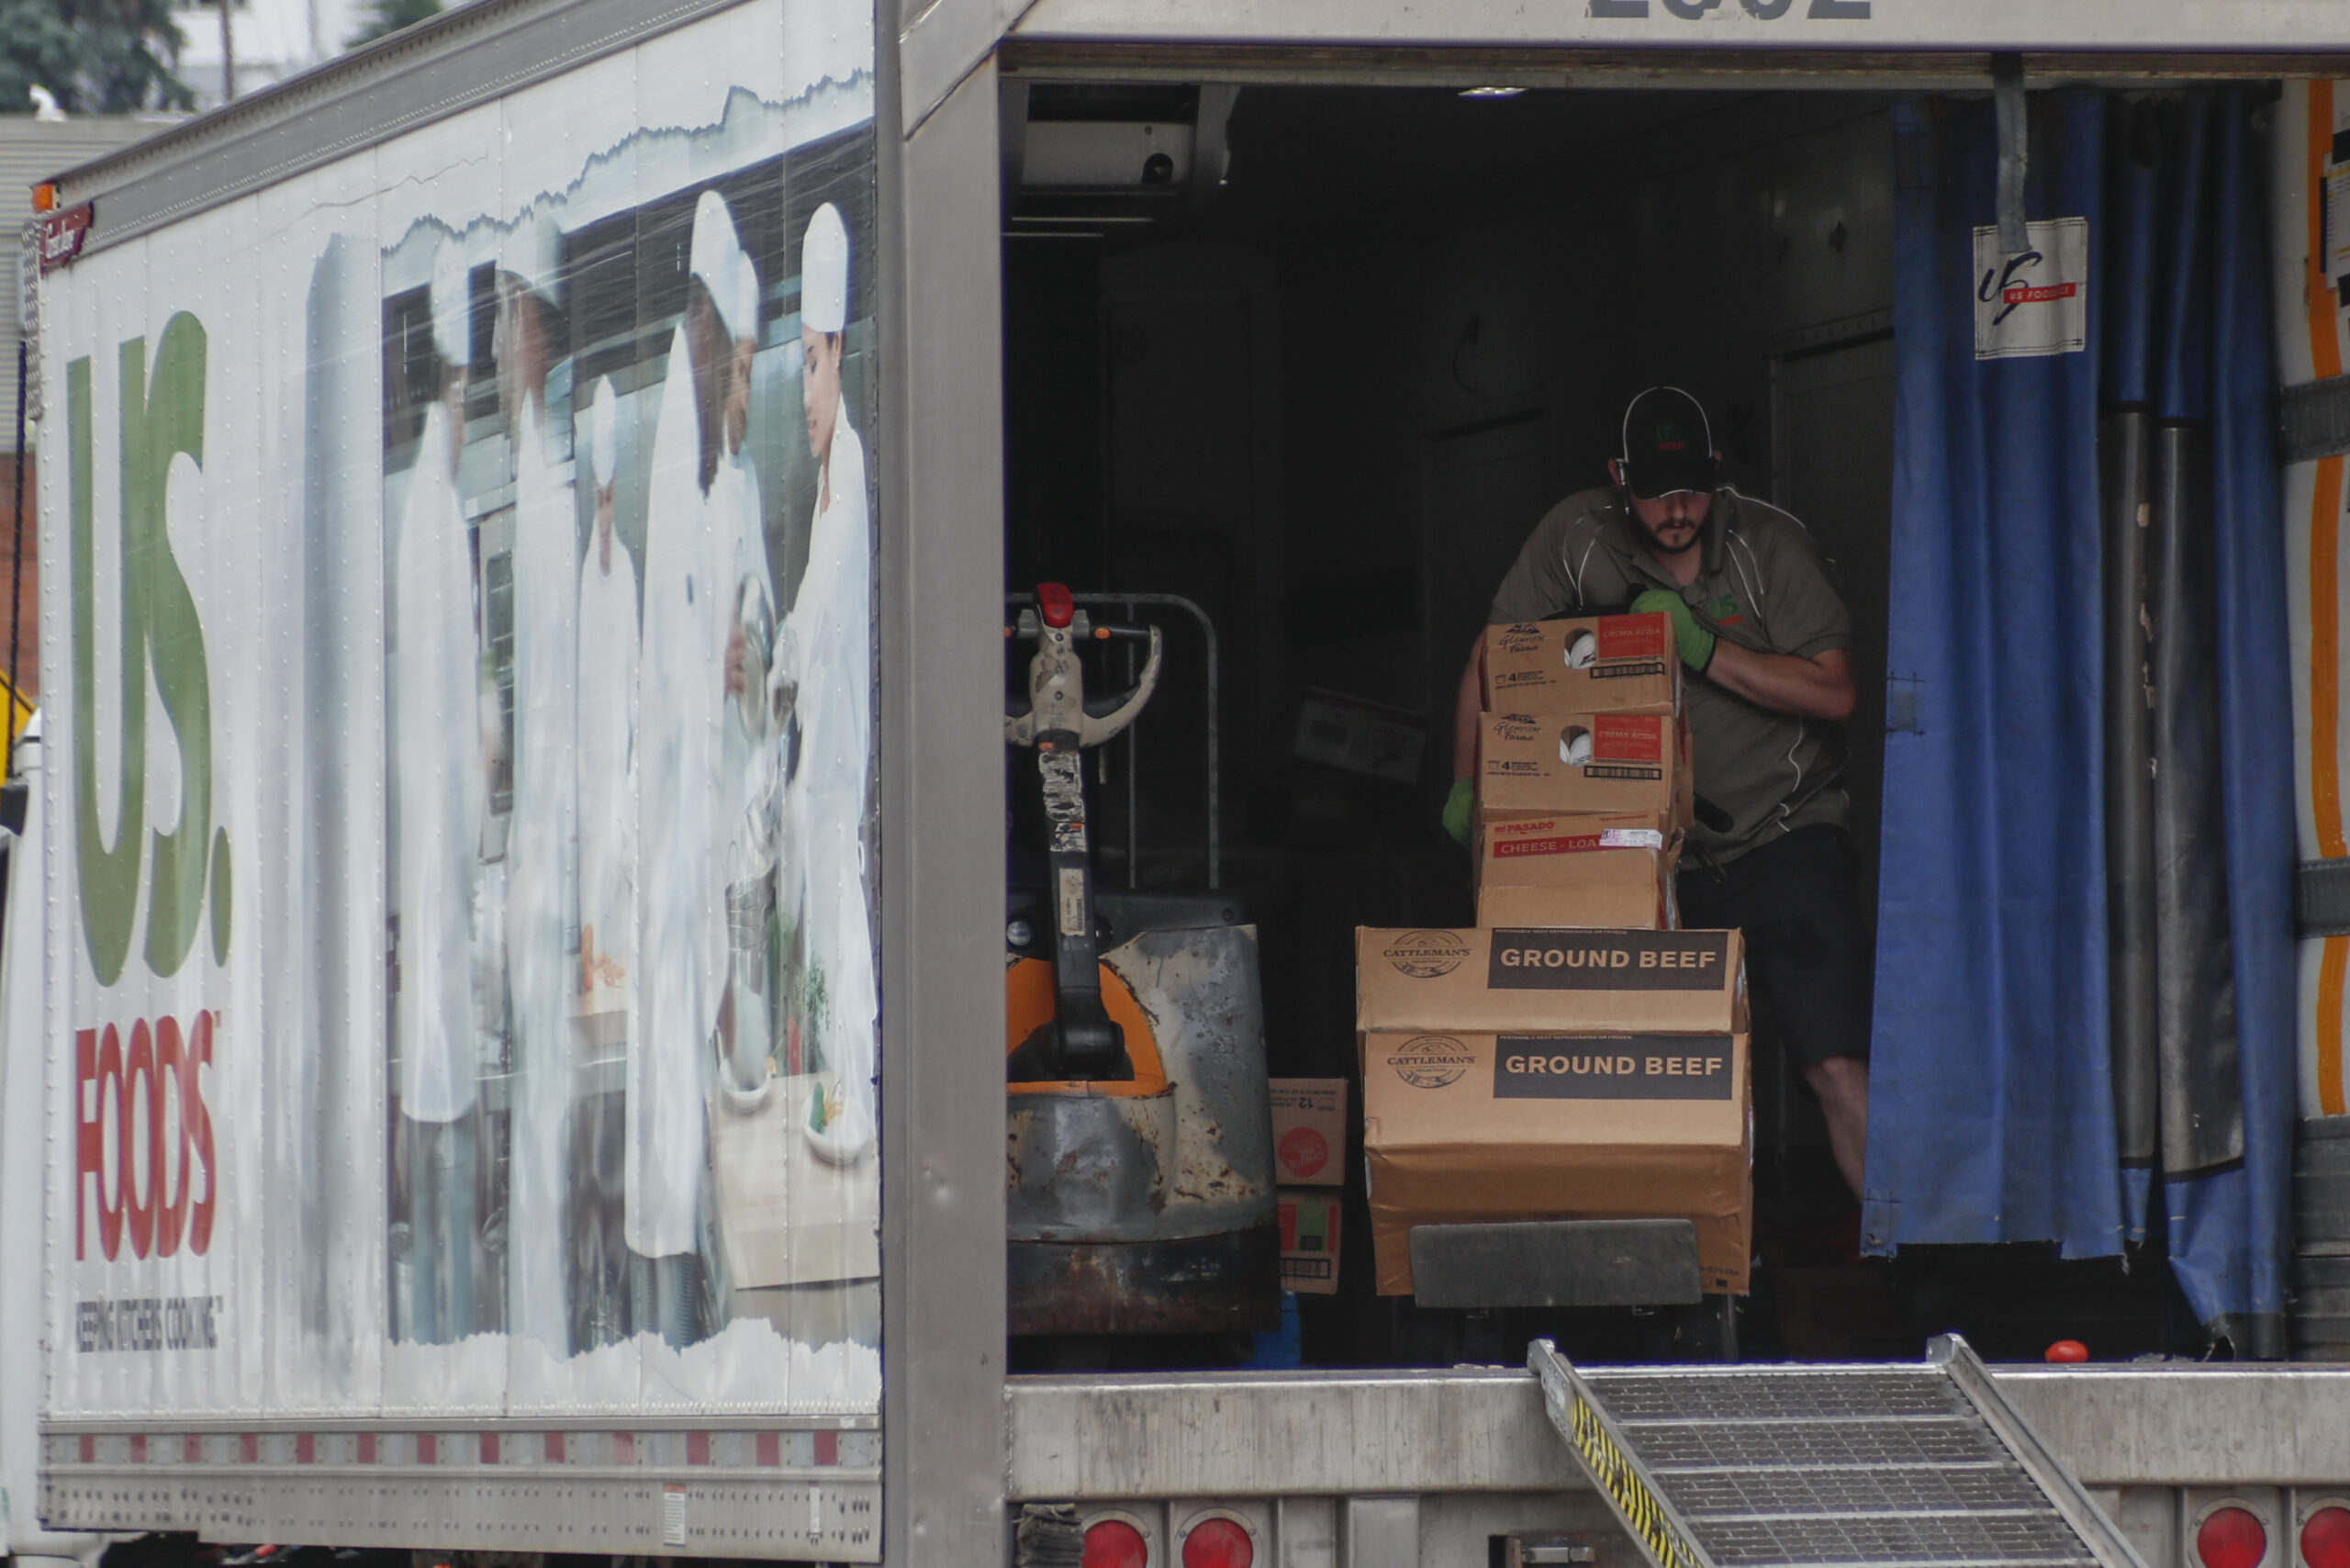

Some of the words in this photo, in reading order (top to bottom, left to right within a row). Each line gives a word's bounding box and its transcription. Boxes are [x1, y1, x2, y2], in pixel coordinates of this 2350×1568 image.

[2009, 291, 2023, 300] US
[1508, 674, 1516, 682] 4
[1502, 761, 1510, 770] 4
[1506, 822, 1555, 834] PASADO
[1501, 839, 1557, 854] CHEESE
[1569, 838, 1597, 849] LOA
[1382, 947, 1471, 958] CATTLEMAN'S
[1500, 947, 1630, 968] GROUND
[1639, 950, 1717, 969] BEEF
[1387, 1056, 1476, 1066] CATTLEMAN'S
[1505, 1055, 1636, 1076] GROUND
[1644, 1056, 1723, 1076] BEEF
[75, 1009, 217, 1262] FOODS
